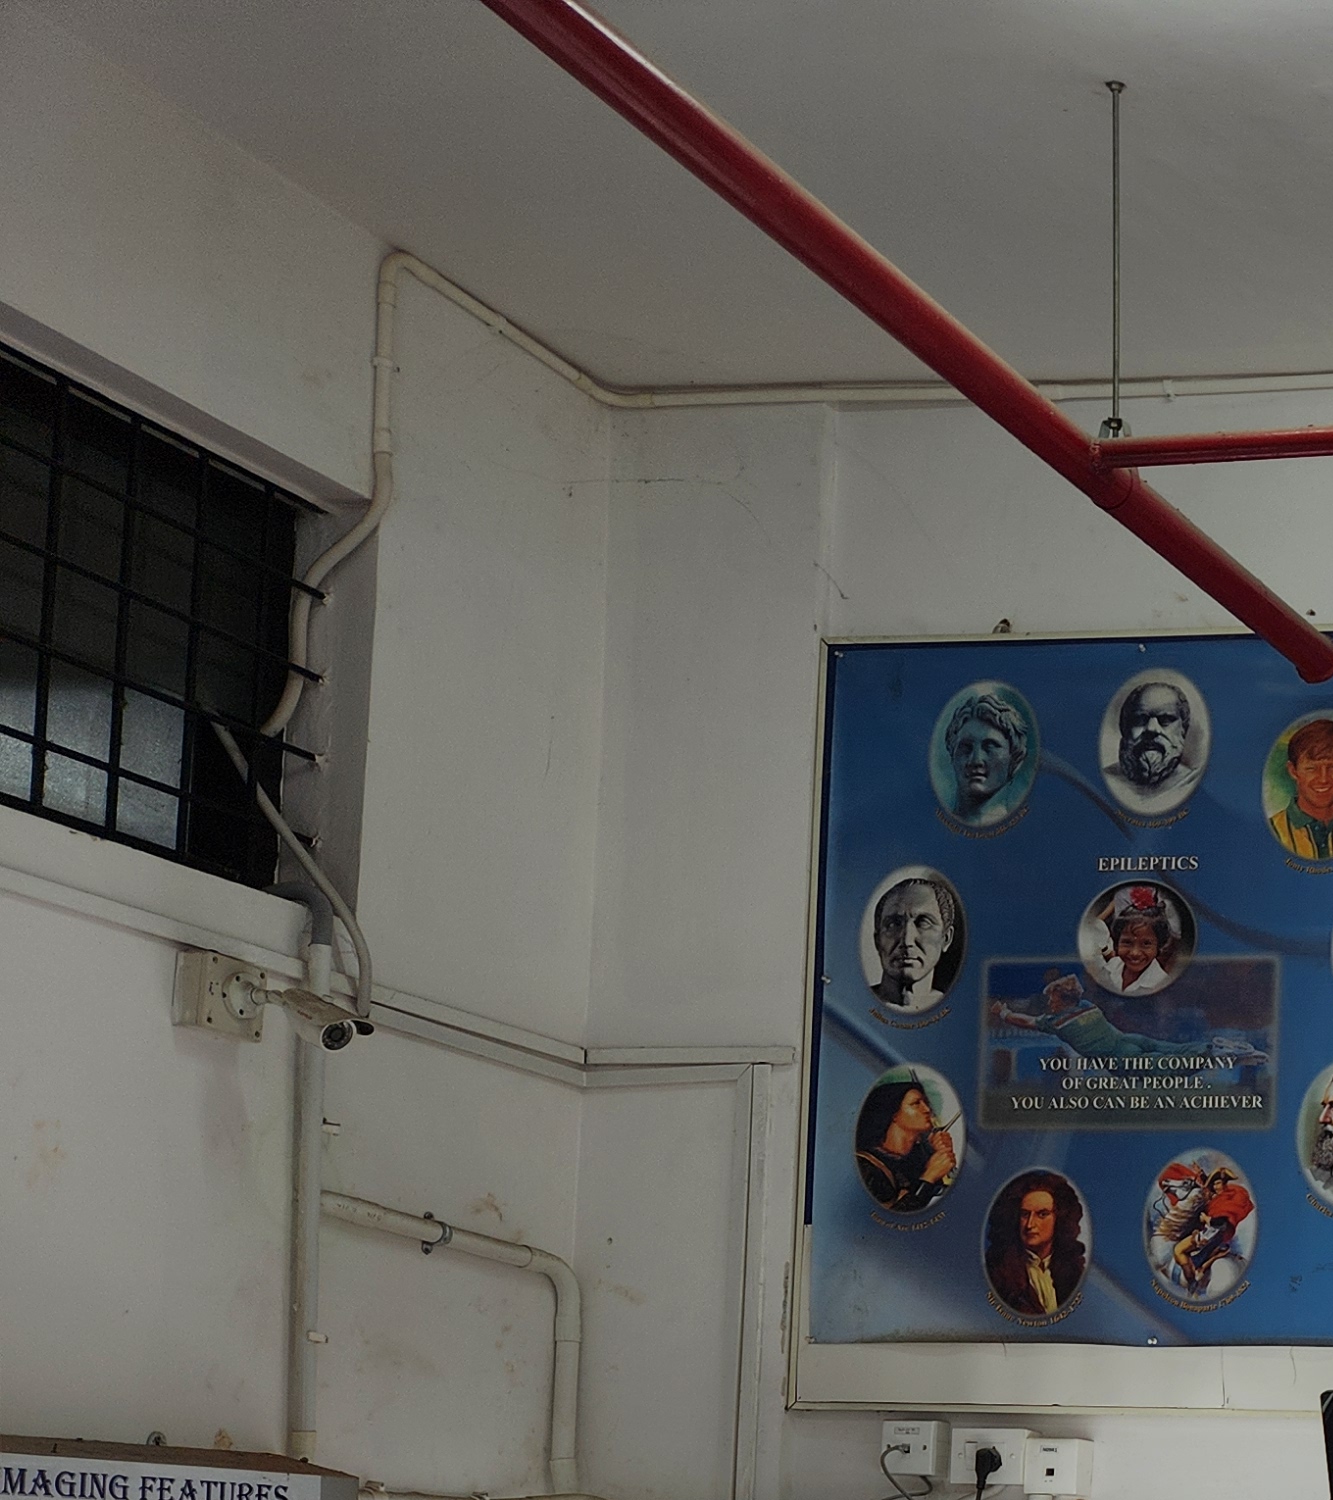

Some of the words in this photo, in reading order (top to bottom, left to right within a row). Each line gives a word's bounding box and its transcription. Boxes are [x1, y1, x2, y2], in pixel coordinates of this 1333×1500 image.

[1097, 856, 1199, 873] EPILEPTICS
[1040, 1058, 1072, 1071] YOU
[1077, 1057, 1118, 1070] HAVE
[1121, 1057, 1153, 1070] THE
[1157, 1056, 1237, 1070] COMPANY
[1062, 1077, 1083, 1090] OF
[1086, 1076, 1139, 1090] GREAT
[1011, 1096, 1045, 1109] YOU
[1047, 1096, 1089, 1110] ALSO
[1092, 1096, 1126, 1109] CAN
[1130, 1096, 1150, 1109] BE
[1153, 1096, 1175, 1109] AN
[1179, 1095, 1263, 1109] ACHIEVER
